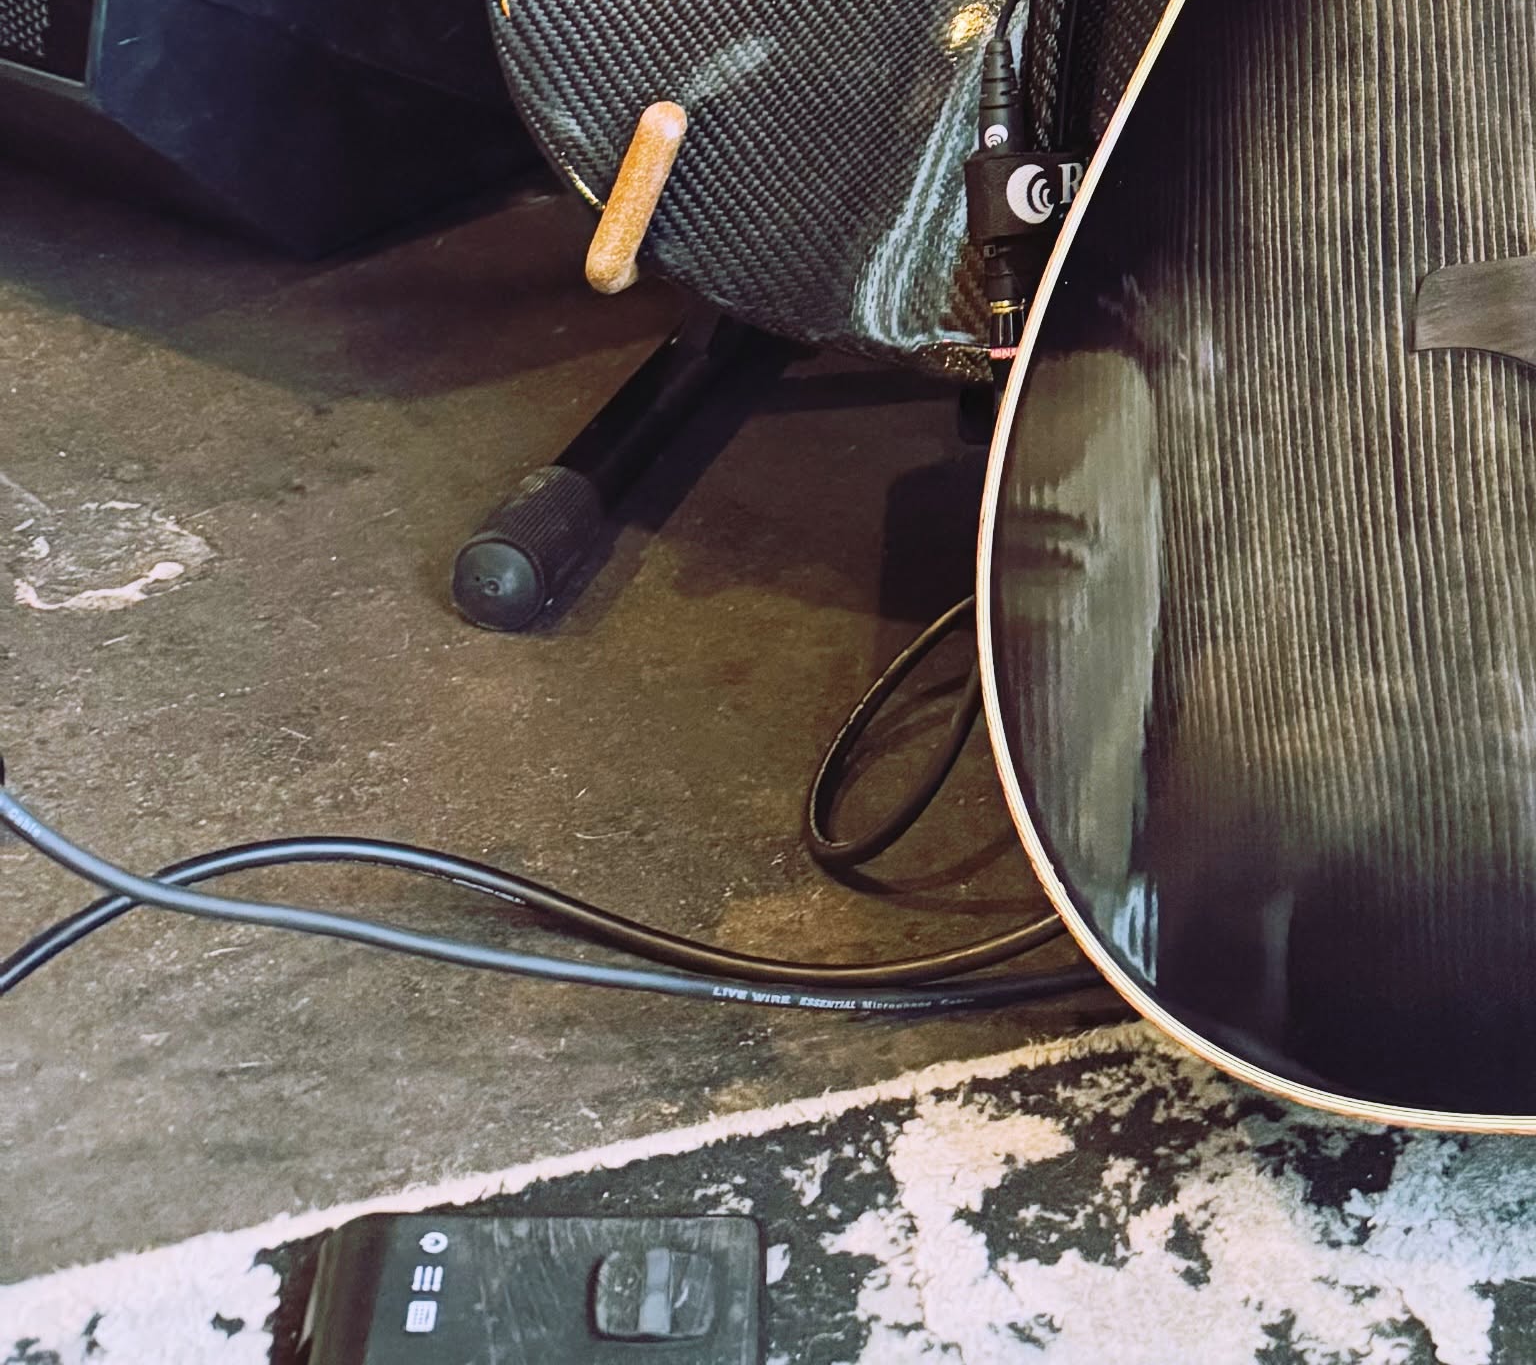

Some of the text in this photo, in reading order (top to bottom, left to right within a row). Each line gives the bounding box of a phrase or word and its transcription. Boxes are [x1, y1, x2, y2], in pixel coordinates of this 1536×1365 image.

[712, 986, 748, 1000] LIVE
[751, 992, 792, 1005] WIRE
[799, 996, 857, 1009] ESSENTIAL
